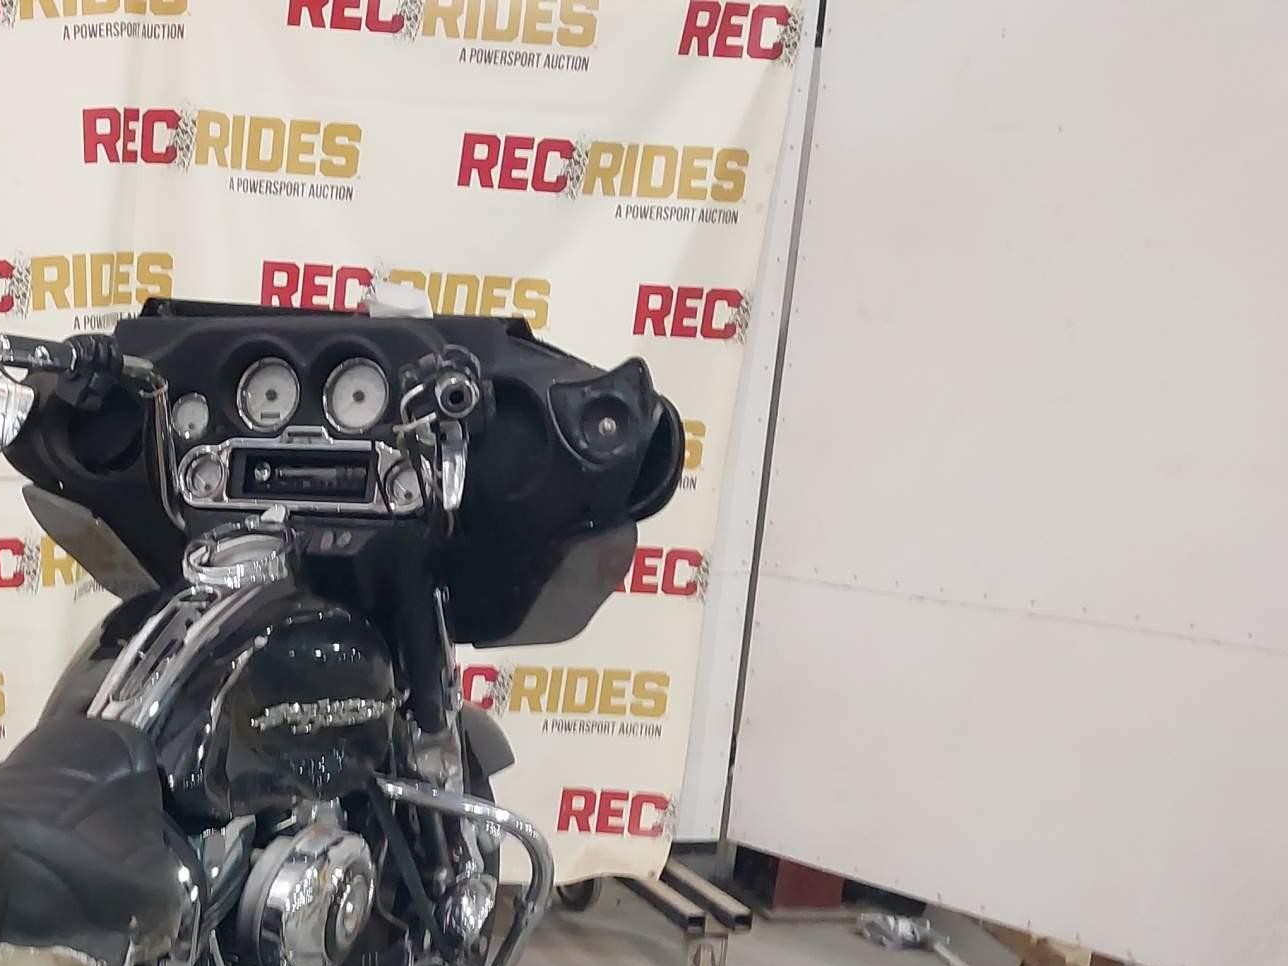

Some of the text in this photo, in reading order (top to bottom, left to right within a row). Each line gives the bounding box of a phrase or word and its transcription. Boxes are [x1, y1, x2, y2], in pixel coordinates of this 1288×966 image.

[63, 21, 185, 41] A POWERSPORT AUCTION
[678, 0, 790, 61] REC
[459, 47, 590, 73] A POWERSPORT AUCTION
[83, 108, 362, 179] REC RIDES
[457, 132, 750, 203] REC RIDES
[229, 176, 354, 202] A POWERSPORT AUCTION
[615, 204, 739, 225] A POWERSPORT AUCTION
[31, 252, 175, 311] RIDES
[261, 261, 374, 313] REC
[633, 285, 745, 340] REC
[616, 547, 703, 596] EC
[508, 665, 671, 718] RIDES
[542, 718, 663, 738] A POWERSPORT AUCTION
[557, 786, 671, 838] REC
